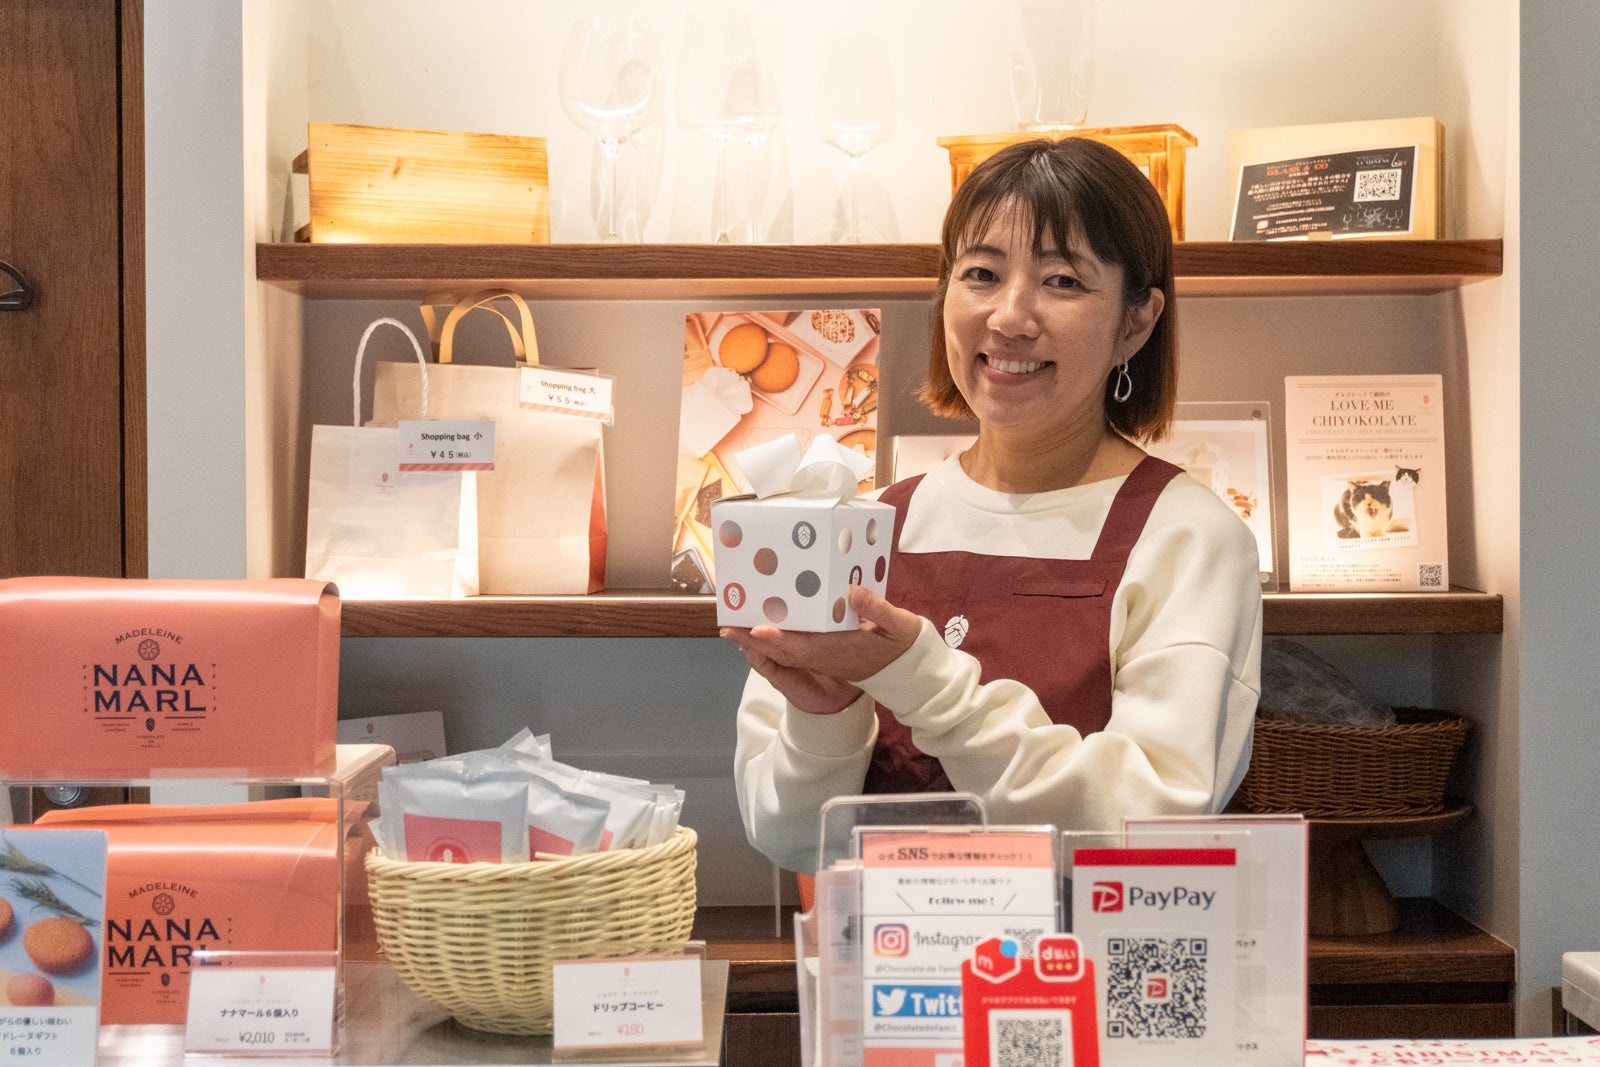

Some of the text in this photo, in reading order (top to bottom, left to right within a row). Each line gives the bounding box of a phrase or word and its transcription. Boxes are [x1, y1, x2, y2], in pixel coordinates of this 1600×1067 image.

[540, 380, 572, 392] Shopping
[573, 384, 587, 394] bag
[1330, 399, 1394, 411] LOVE ME
[1312, 415, 1417, 427] CHIYOKOLATE
[421, 431, 483, 442] Shopping bag 小
[114, 628, 184, 644] MADELEINE
[93, 664, 206, 687] NANA
[94, 689, 207, 713] MARL
[128, 882, 198, 899] MADELEINE
[928, 897, 965, 905] Follow
[1129, 886, 1216, 911] PayPay
[107, 919, 220, 942] NANA
[108, 945, 222, 968] MARL
[220, 1009, 299, 1018] ナナマール6個入り
[593, 1001, 664, 1013] ドリップコーヒー
[616, 1023, 645, 1036] ¥180
[0, 1032, 58, 1041] ドレーヌギフト
[239, 1031, 276, 1045] ¥2,010
[9, 1047, 41, 1056] 6個入り
